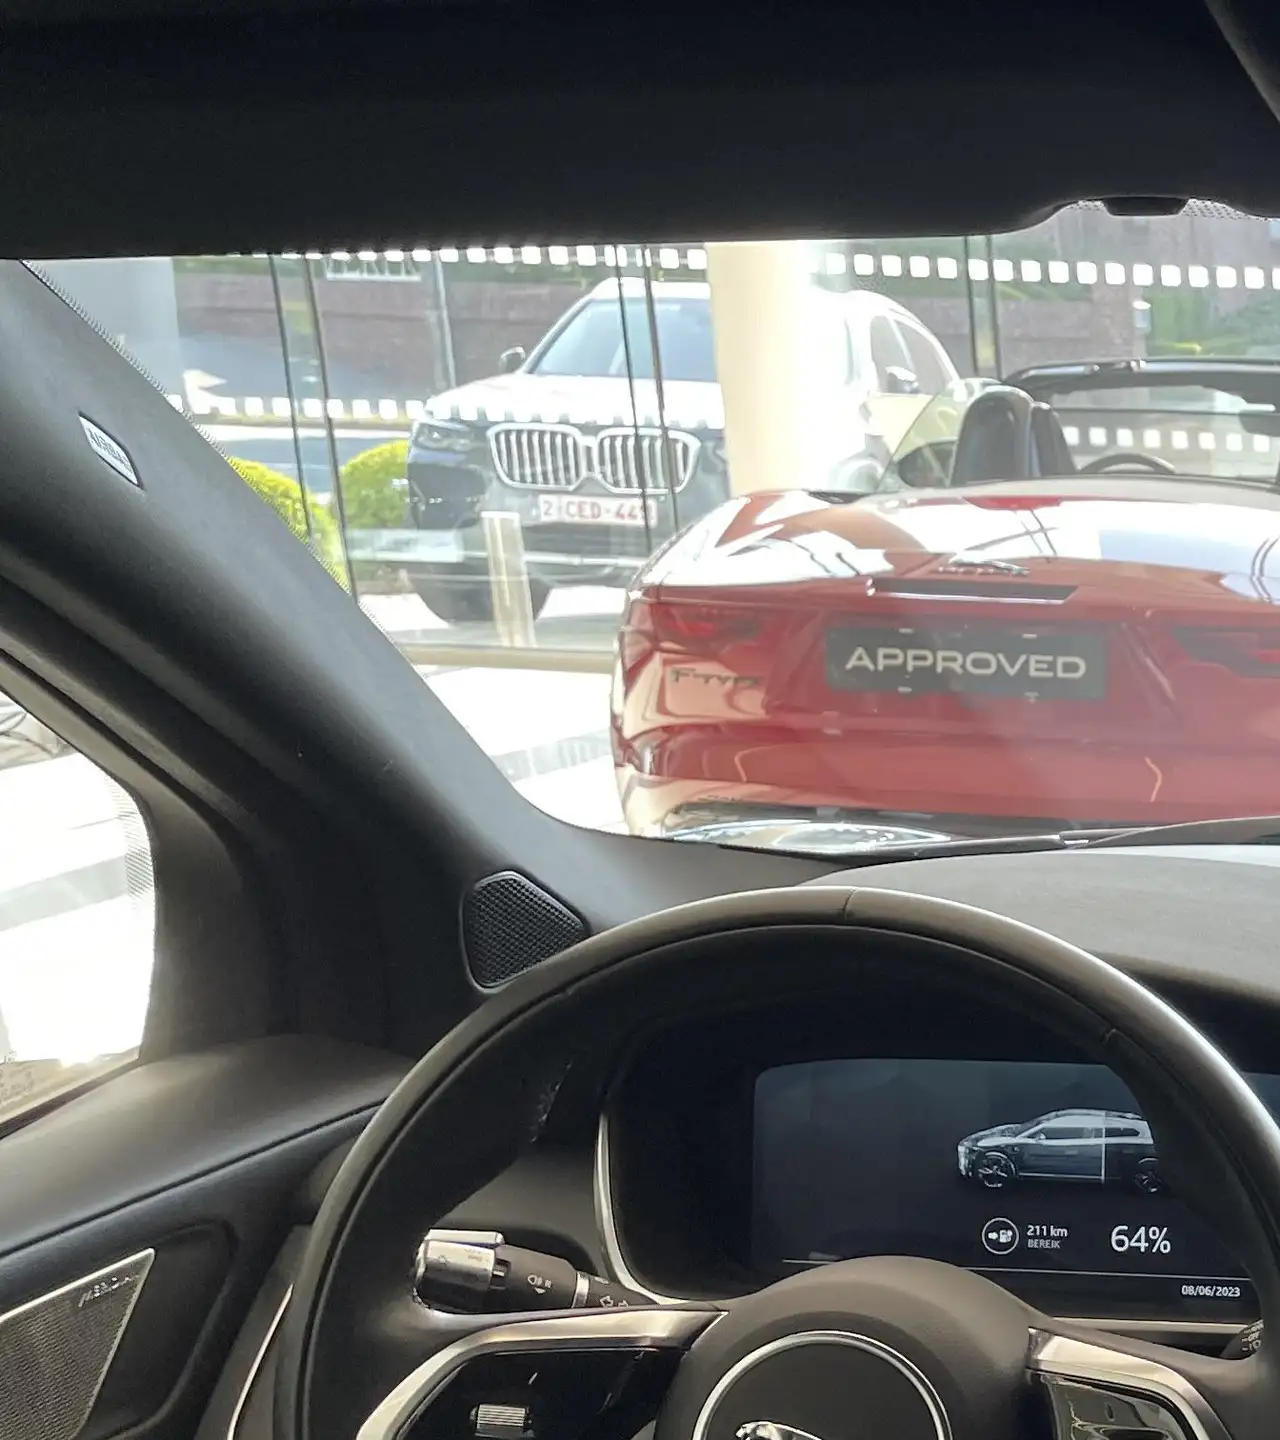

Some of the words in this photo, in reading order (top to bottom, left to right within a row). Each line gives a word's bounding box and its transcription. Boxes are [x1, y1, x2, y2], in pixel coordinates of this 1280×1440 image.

[845, 646, 1087, 679] APPROVED
[1027, 1225, 1047, 1237] 211
[1051, 1226, 1068, 1238] km
[1027, 1238, 1061, 1249] BEREIK
[1110, 1225, 1172, 1254] 64%
[1181, 1285, 1241, 1297] 08/06/2023
